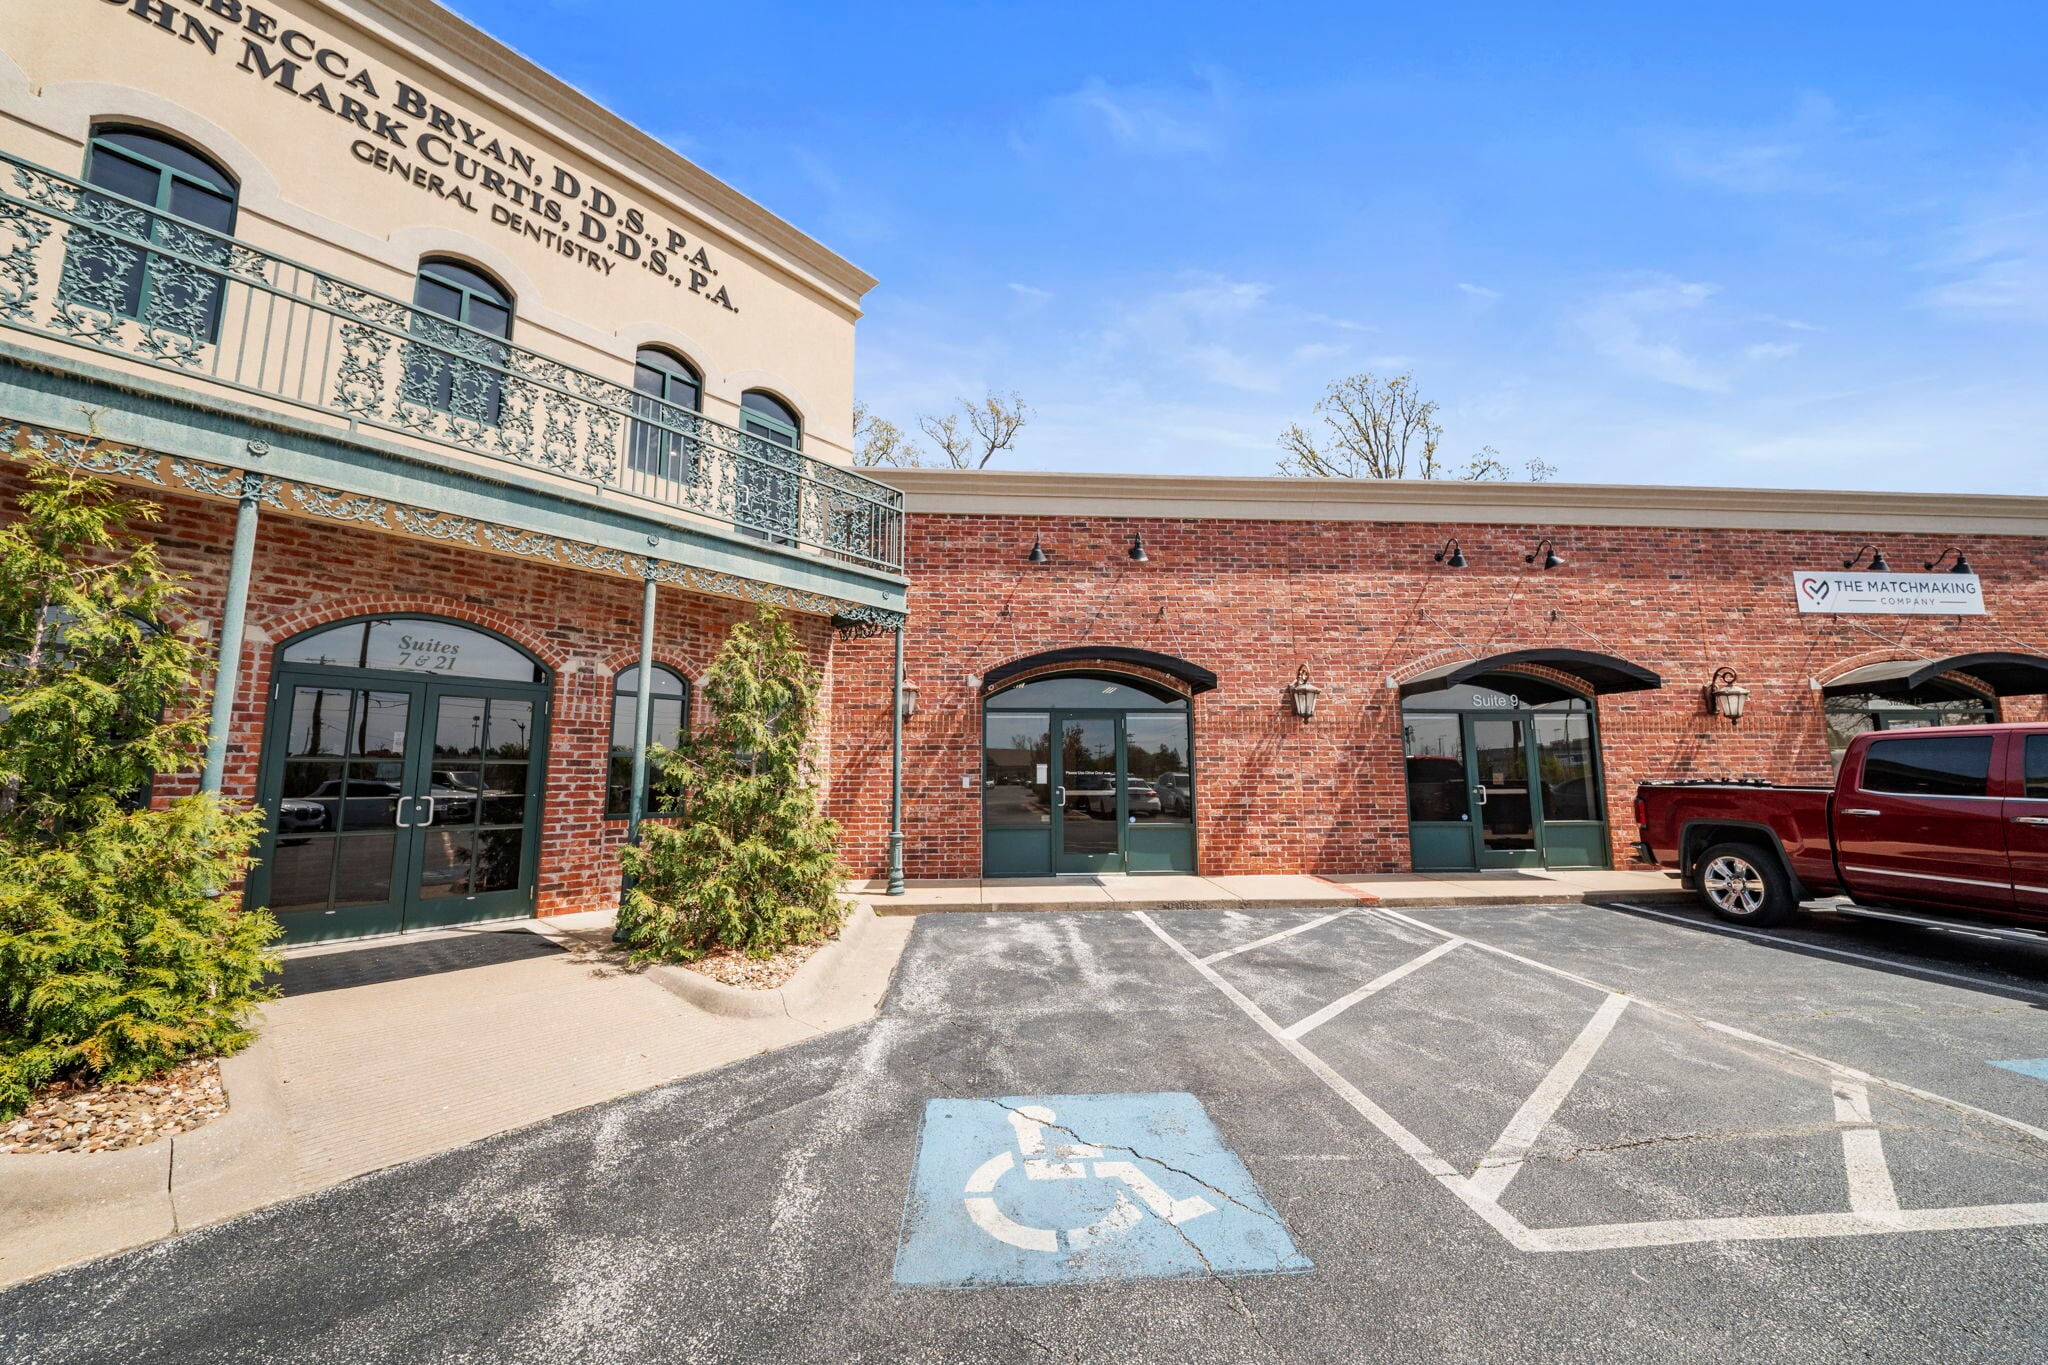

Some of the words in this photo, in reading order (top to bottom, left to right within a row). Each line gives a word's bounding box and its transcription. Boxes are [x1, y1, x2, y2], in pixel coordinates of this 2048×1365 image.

[181, 0, 380, 99] BECCA
[392, 79, 543, 187] BRYAN,
[551, 165, 659, 247] D.D.S.,
[665, 227, 719, 277] P.A.
[99, 0, 224, 55] HN
[235, 36, 408, 149] MARK
[416, 132, 570, 232] CURTIS,
[578, 211, 682, 288] D.D.S.,
[688, 268, 740, 314] P.A.
[350, 139, 478, 213] GENERAL
[491, 203, 616, 277] DENTISTRY
[1834, 580, 1863, 593] THE
[1868, 580, 1976, 595] MATCHMAKING
[1880, 597, 1936, 606] COMPANY
[398, 635, 460, 655] Suites
[399, 652, 412, 666] 7
[415, 655, 431, 667] &
[433, 656, 457, 671] 21
[1472, 694, 1507, 708] Suite
[1510, 694, 1519, 708] 9
